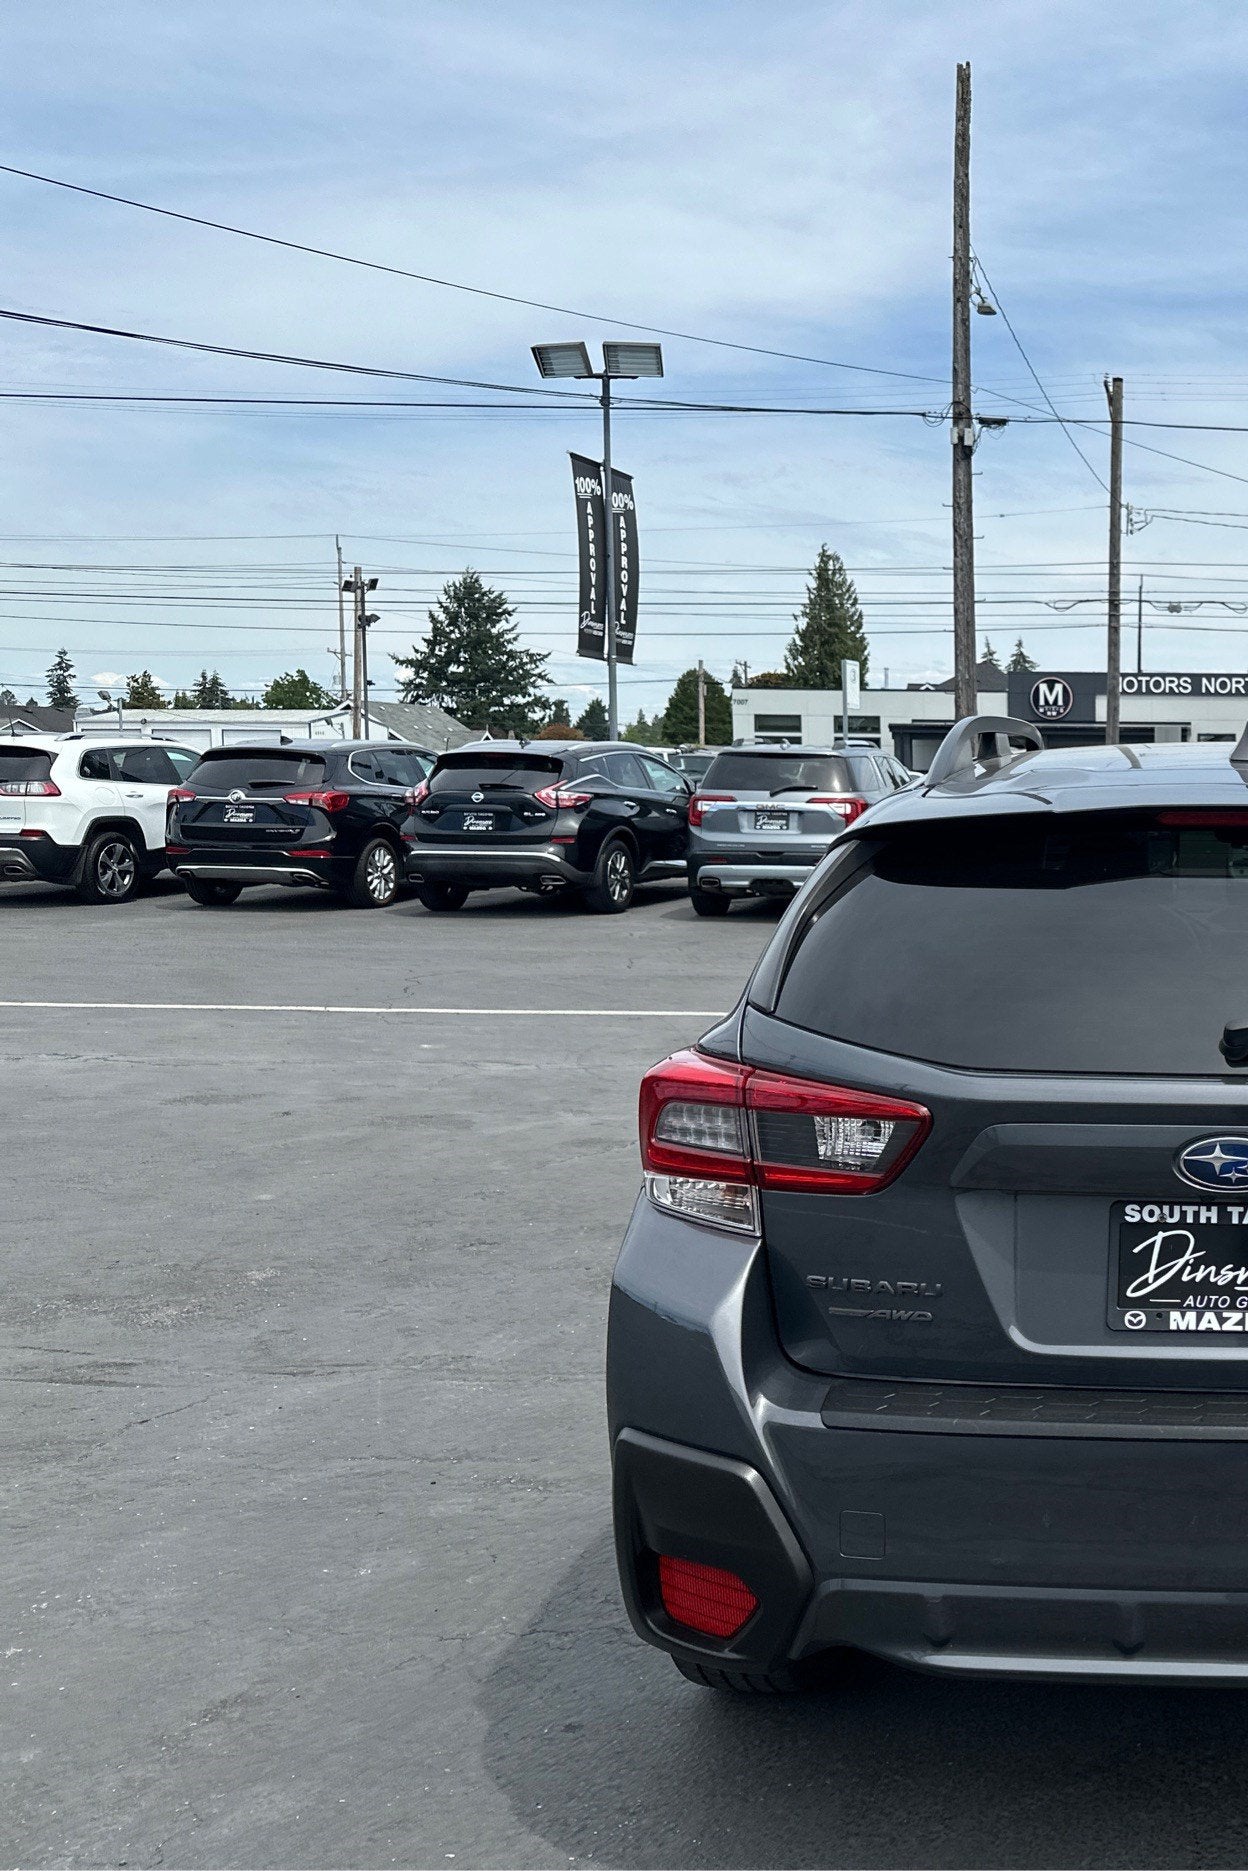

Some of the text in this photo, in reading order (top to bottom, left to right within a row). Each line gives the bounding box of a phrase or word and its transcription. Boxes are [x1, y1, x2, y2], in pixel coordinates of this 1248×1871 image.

[575, 476, 601, 496] 100%
[612, 492, 634, 511] 00%
[587, 501, 597, 615] APPROVAL
[619, 516, 628, 625] APPROVAL
[1039, 683, 1064, 706] M
[1124, 1204, 1218, 1224] SOUTH
[805, 1274, 944, 1298] SUBARU
[1183, 1295, 1230, 1308] AUTO
[865, 1309, 933, 1322] AWD
